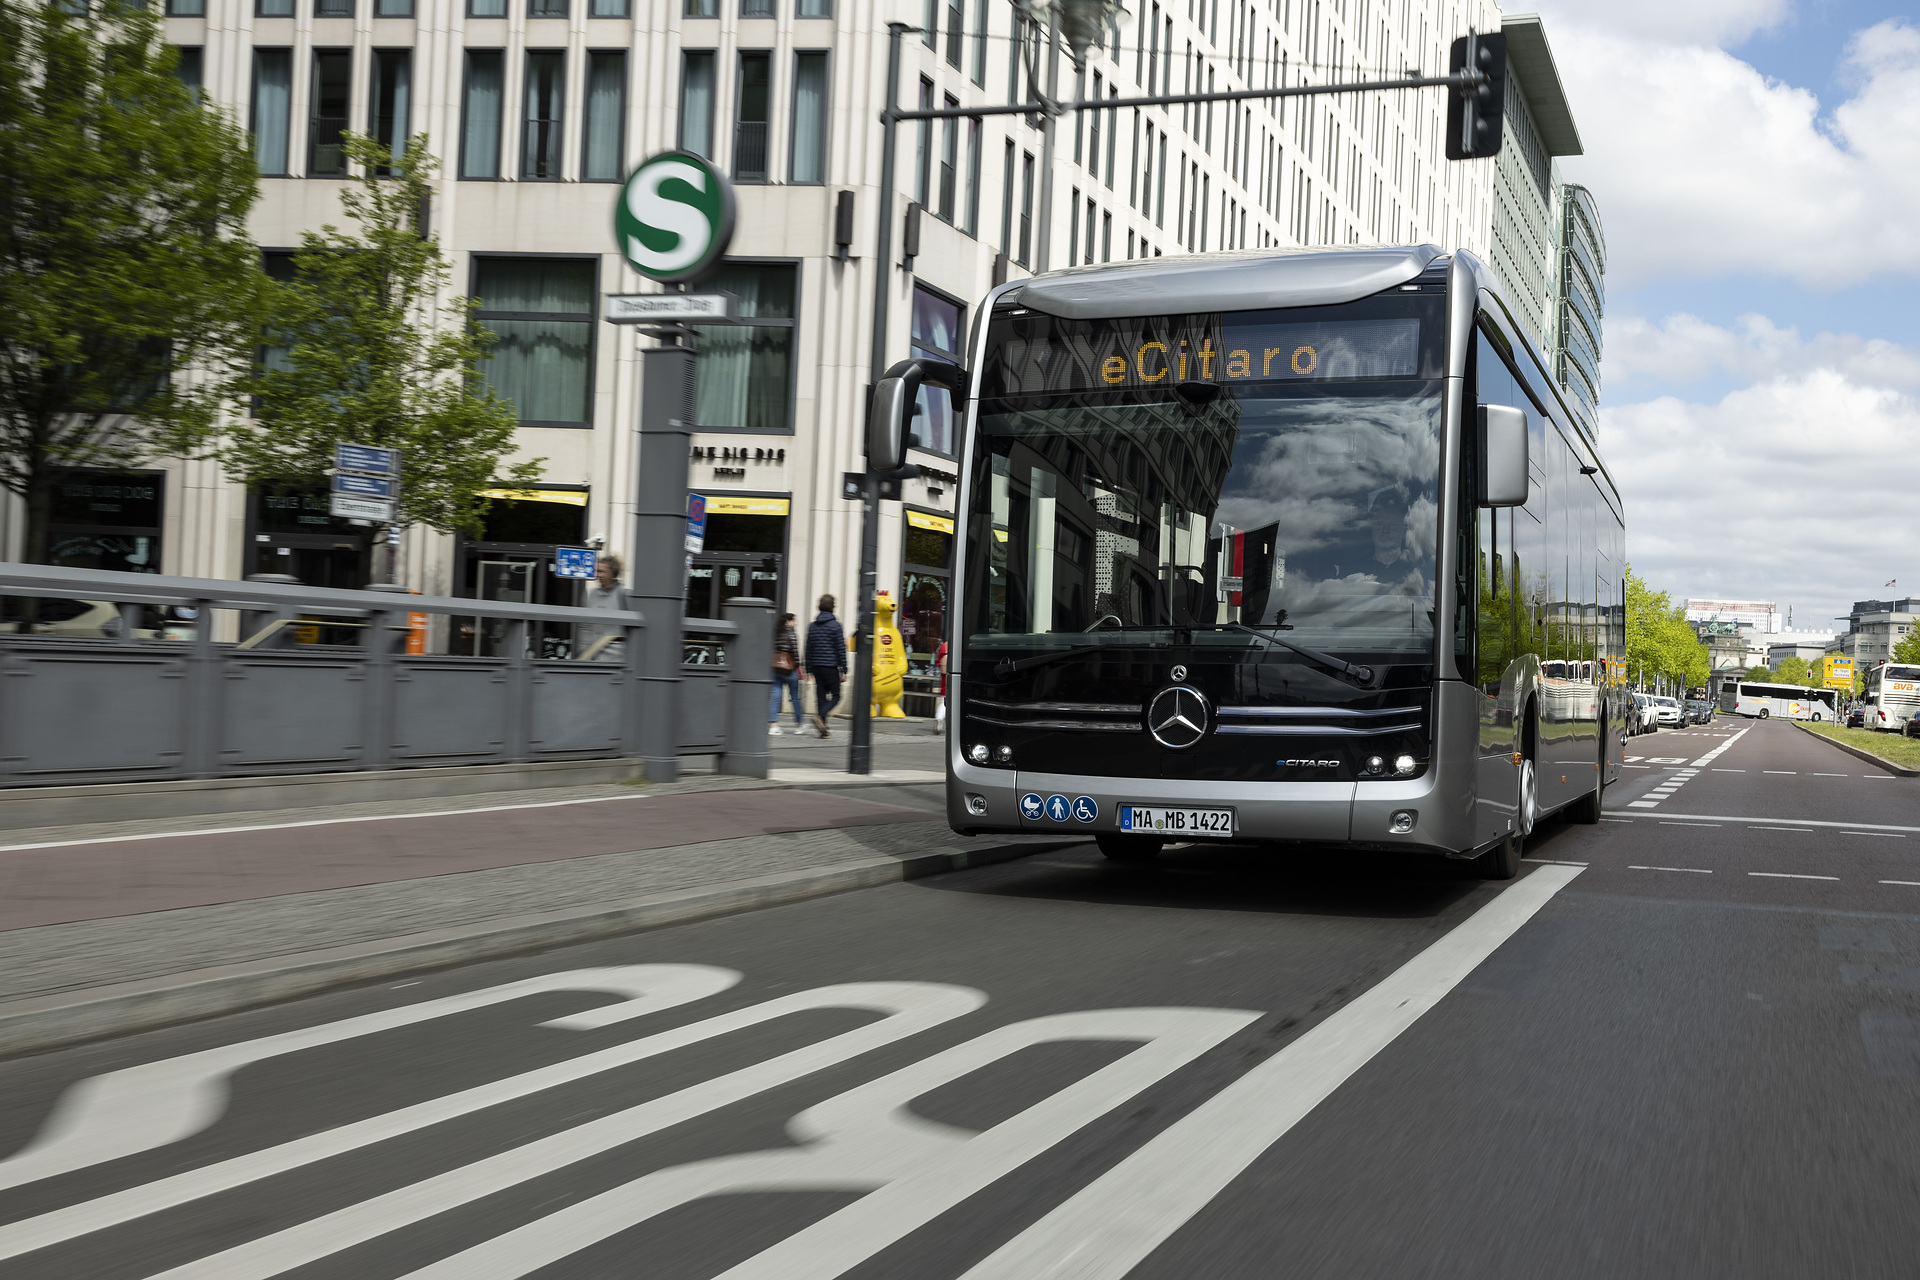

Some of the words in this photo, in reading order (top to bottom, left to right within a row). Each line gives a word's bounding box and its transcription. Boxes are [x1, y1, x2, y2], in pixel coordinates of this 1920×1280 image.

[626, 160, 712, 272] S
[1102, 338, 1317, 384] eCitaro
[1893, 682, 1914, 691] BVB
[1276, 759, 1340, 768] eCITARO
[1133, 809, 1153, 828] MA
[1165, 811, 1186, 829] MB
[1189, 812, 1230, 832] 1422
